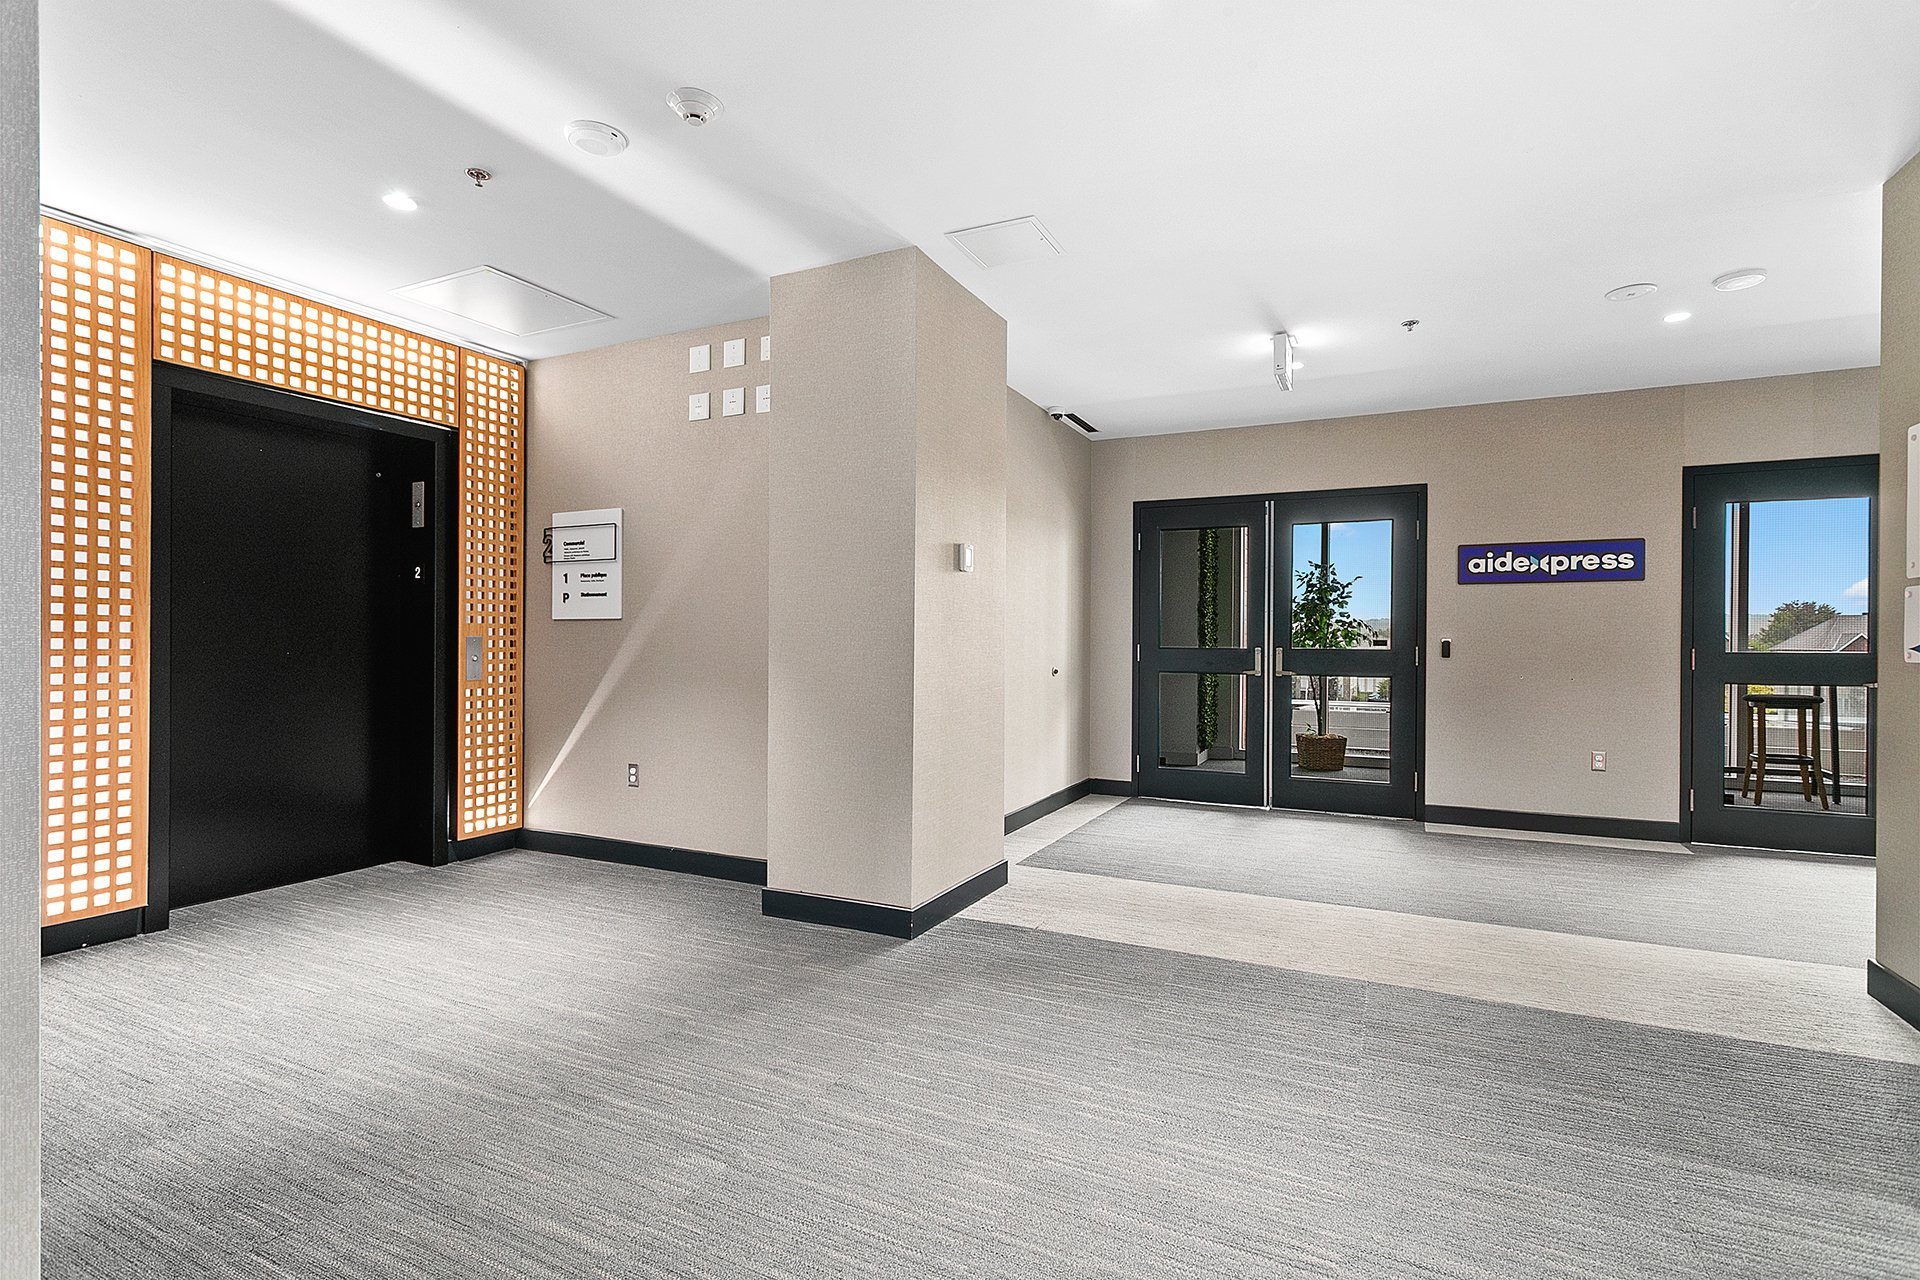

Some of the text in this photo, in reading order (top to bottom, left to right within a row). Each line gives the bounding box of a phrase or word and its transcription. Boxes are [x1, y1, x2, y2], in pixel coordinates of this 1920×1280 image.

[1467, 551, 1635, 576] aidexpress
[414, 566, 420, 578] 2
[563, 572, 568, 584] 1
[563, 593, 569, 603] P
